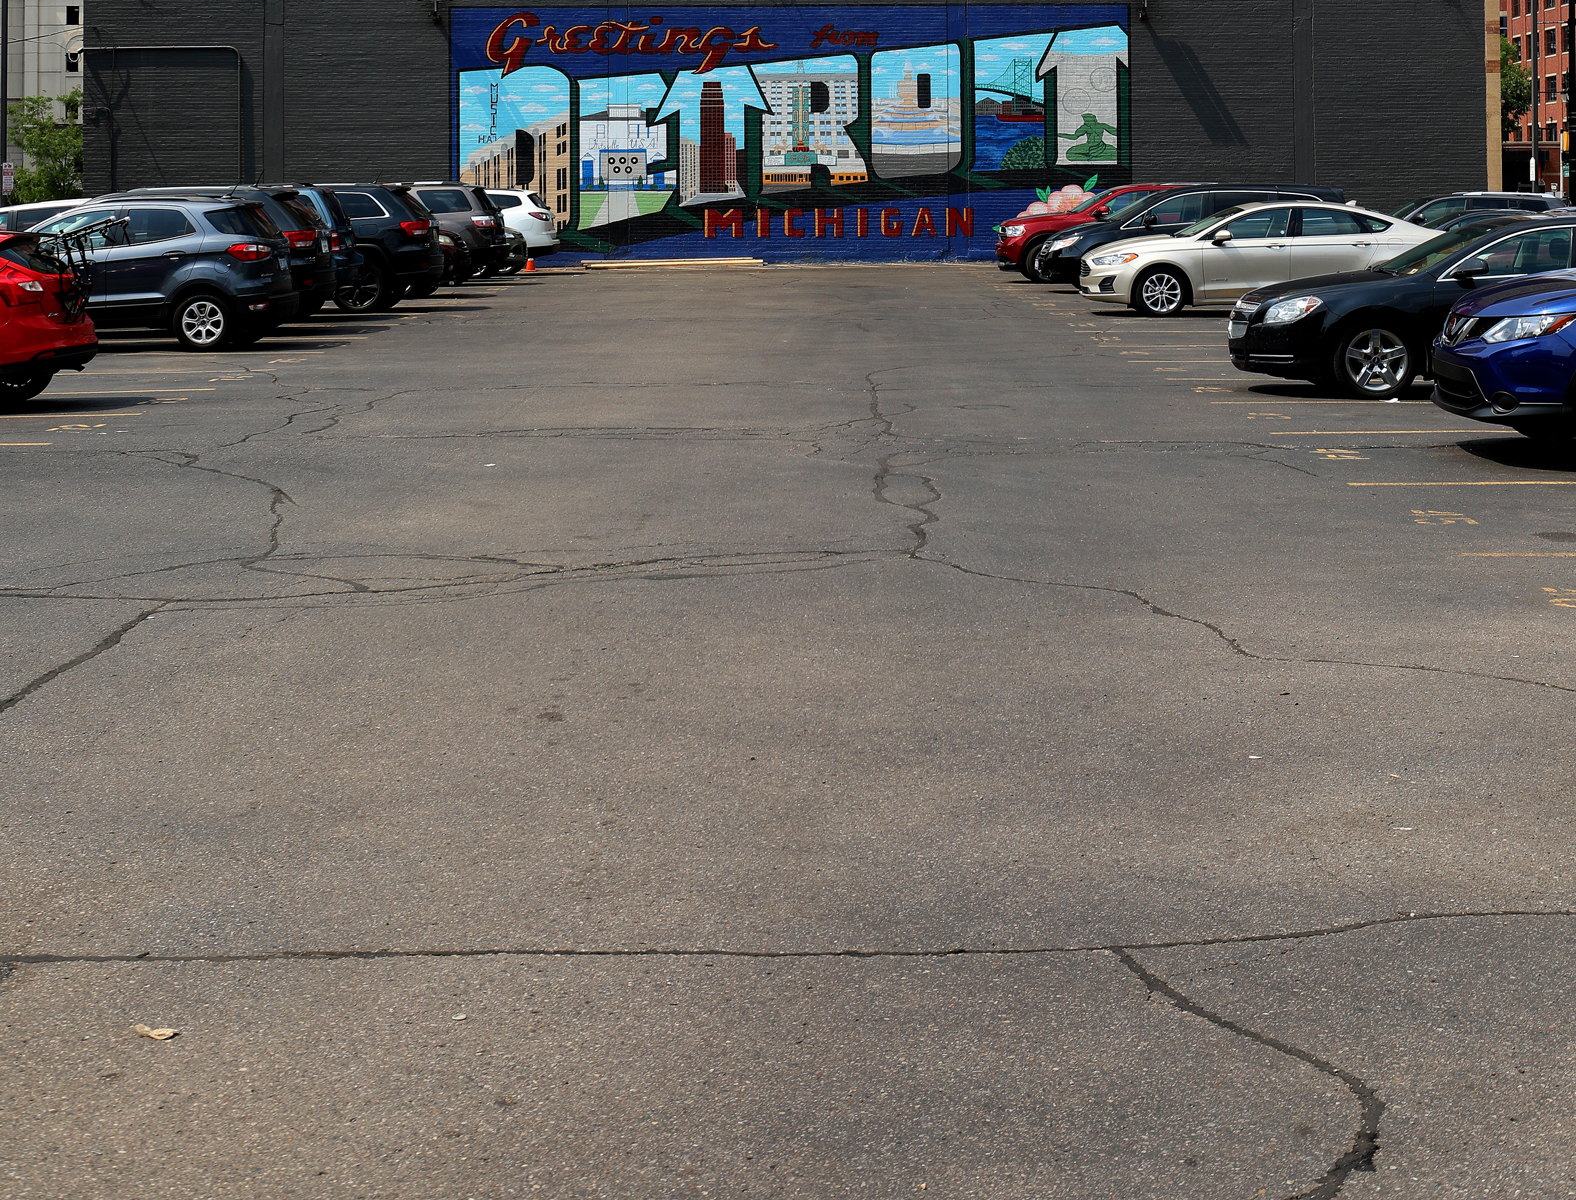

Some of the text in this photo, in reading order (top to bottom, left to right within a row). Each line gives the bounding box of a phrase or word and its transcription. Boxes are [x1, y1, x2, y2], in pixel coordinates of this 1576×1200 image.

[486, 11, 880, 79] Greetings from
[457, 24, 1132, 234] DETROIT
[489, 82, 499, 136] MUSIC
[629, 137, 656, 149] USA
[790, 154, 812, 164] FOX
[704, 206, 975, 238] MICHIGAN
